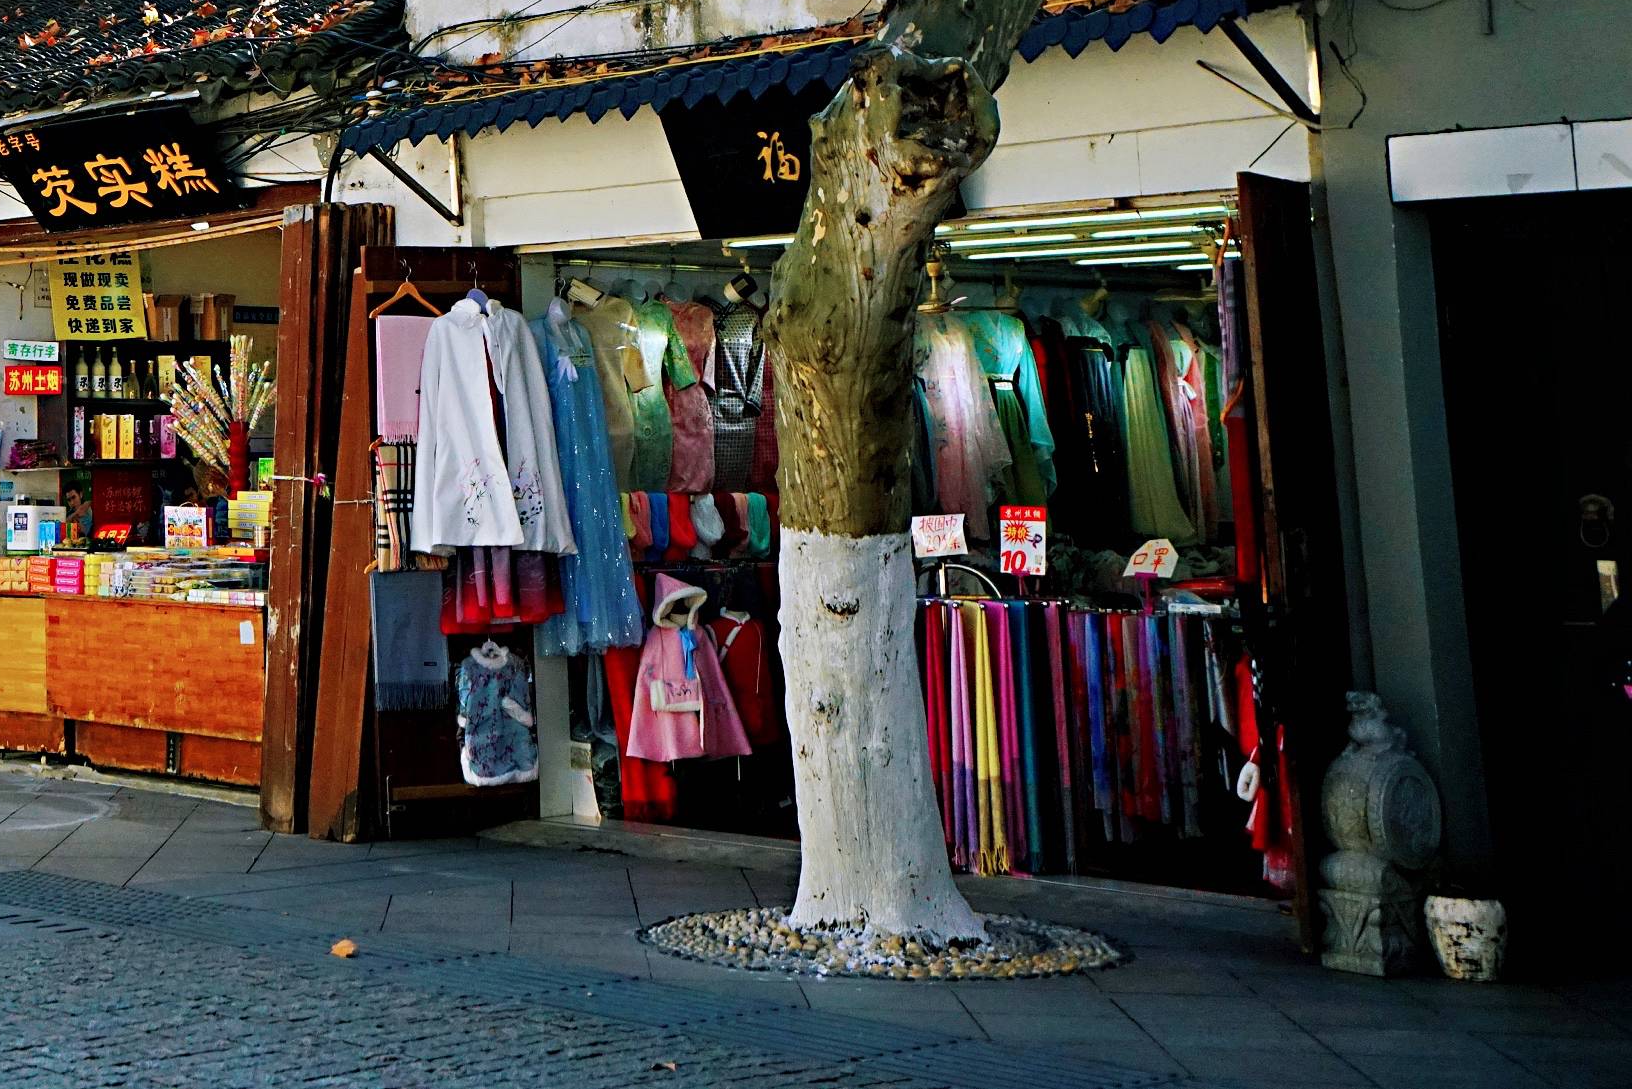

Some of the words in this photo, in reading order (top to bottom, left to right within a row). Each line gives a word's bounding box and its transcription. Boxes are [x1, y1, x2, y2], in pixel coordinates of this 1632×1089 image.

[756, 131, 801, 183] 福
[31, 142, 219, 216] 芡实糕
[63, 272, 129, 288] 现做现卖
[66, 295, 131, 311] 免费品尝
[68, 318, 134, 334] 快递到家
[7, 342, 56, 358] 寄存行李
[8, 369, 60, 392] 苏州土烟
[1007, 526, 1027, 539] 特价
[1001, 549, 1027, 572] 10
[1133, 547, 1169, 573] 口罩
